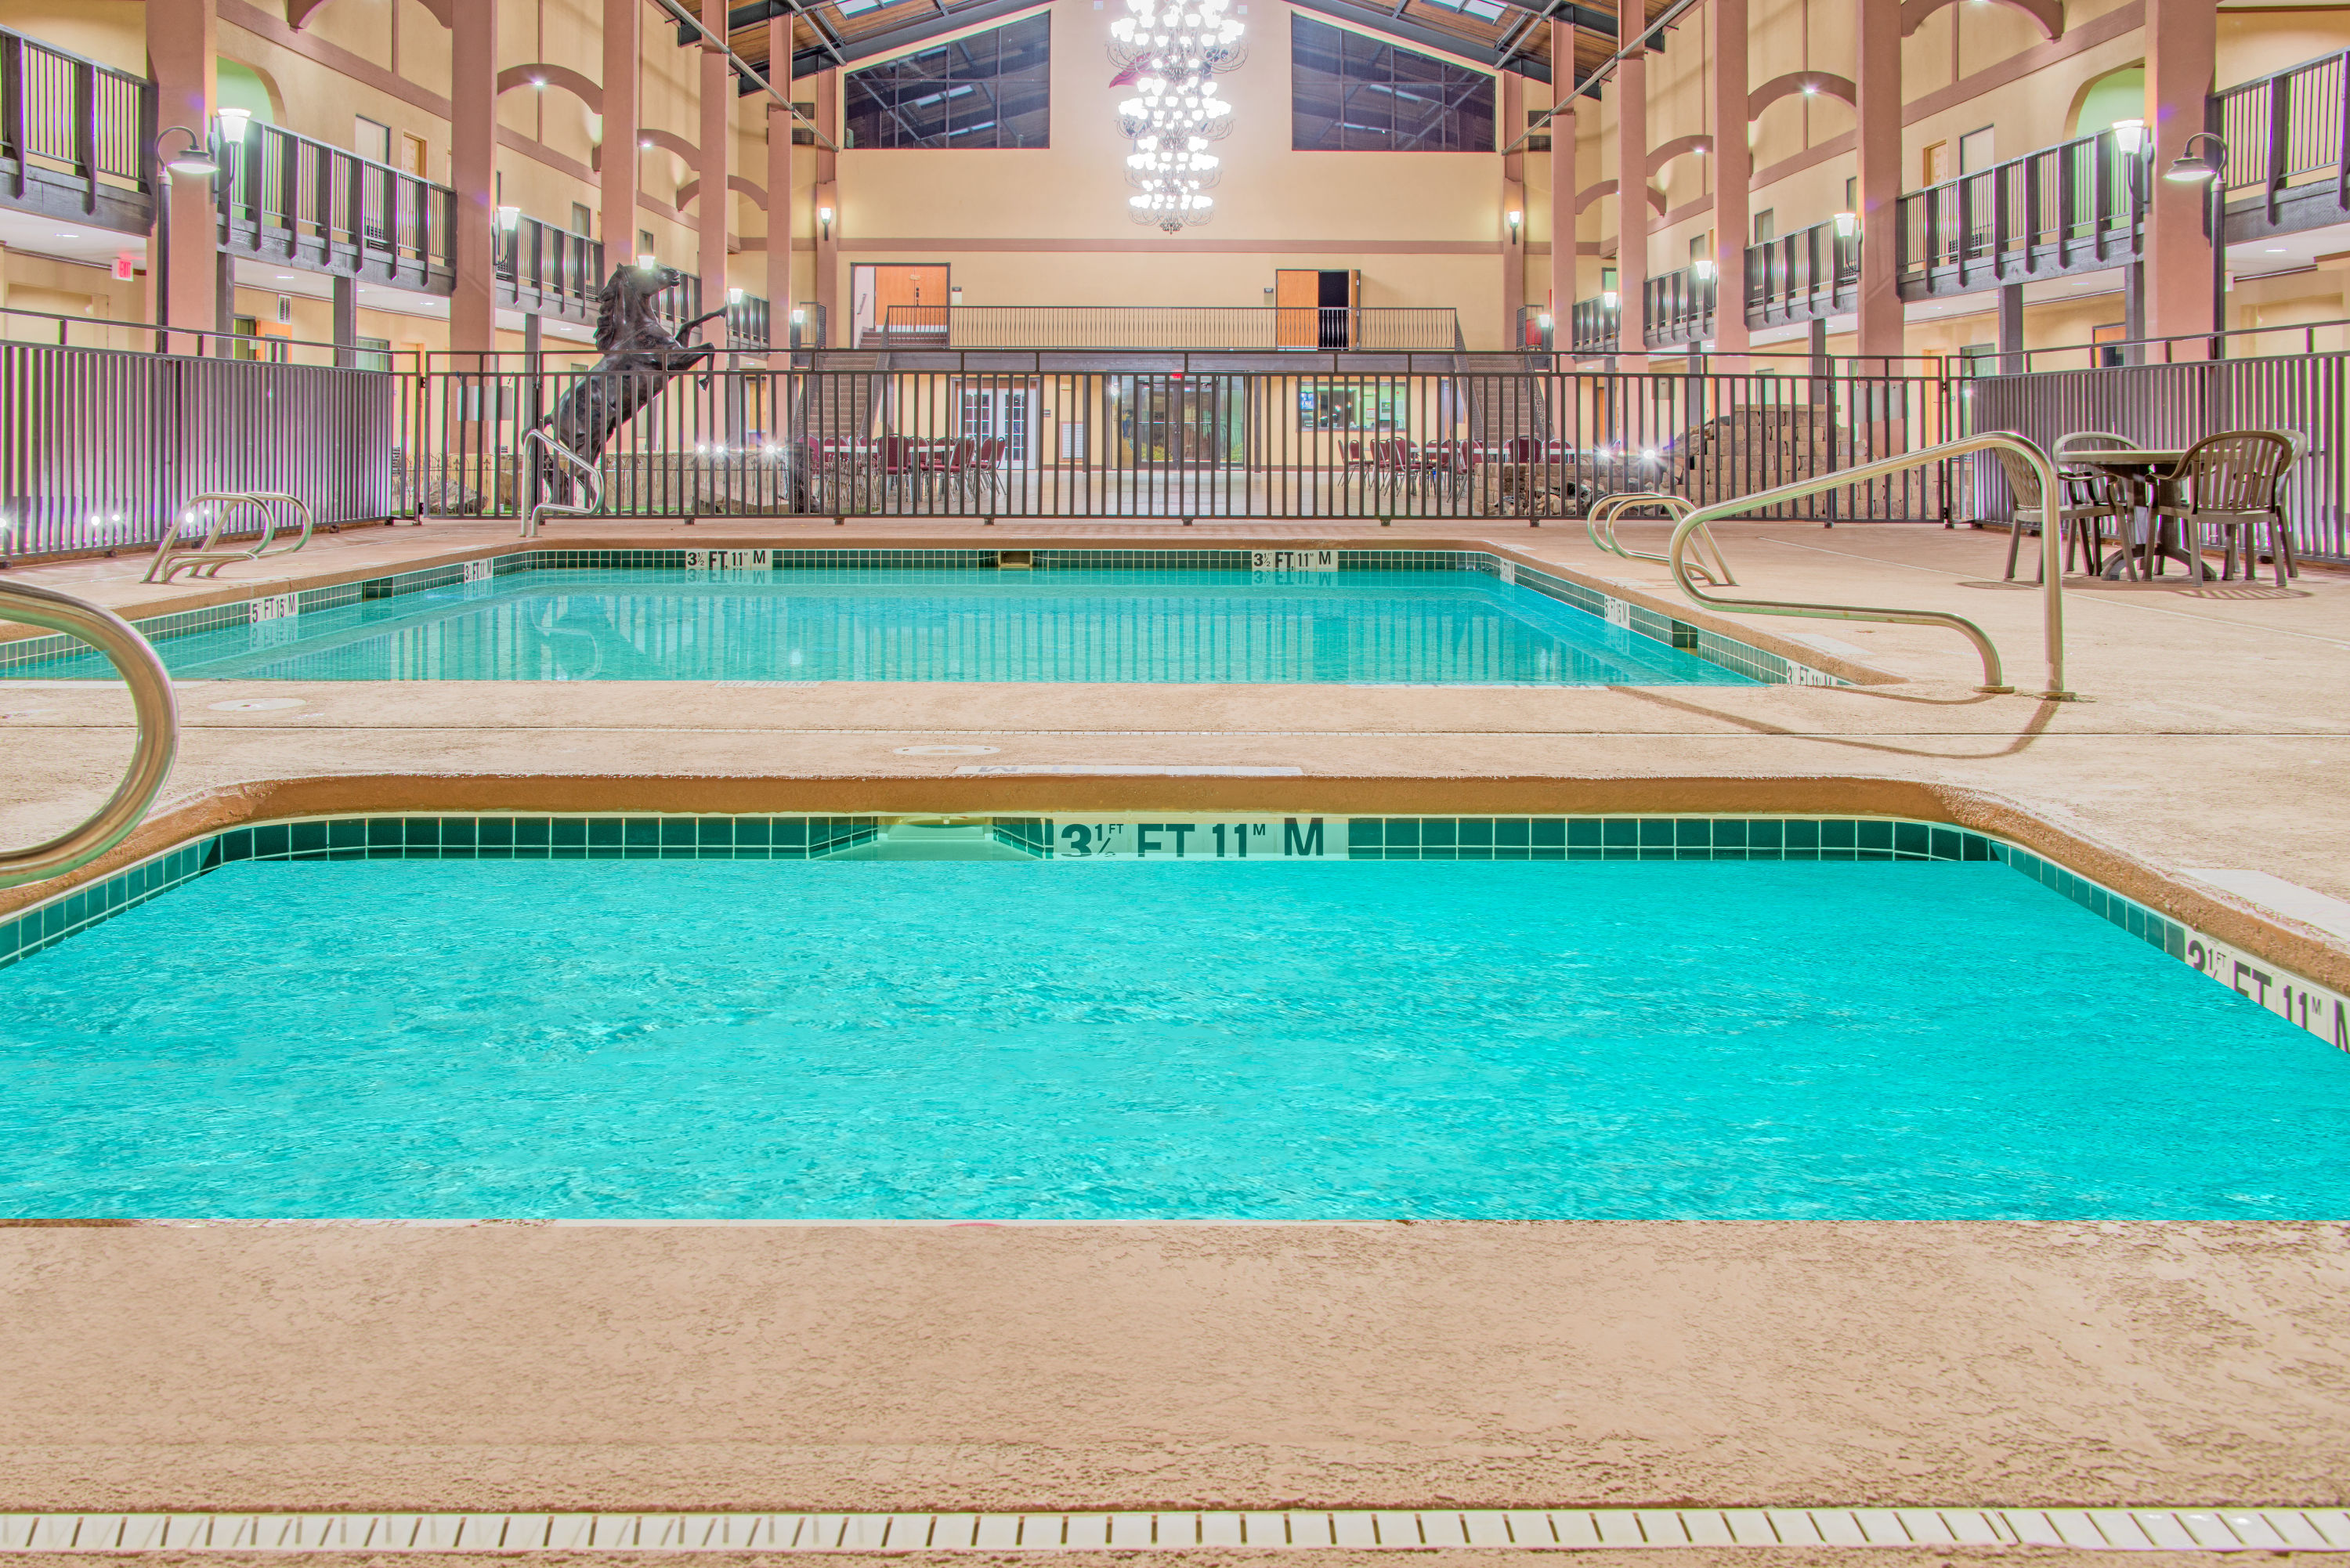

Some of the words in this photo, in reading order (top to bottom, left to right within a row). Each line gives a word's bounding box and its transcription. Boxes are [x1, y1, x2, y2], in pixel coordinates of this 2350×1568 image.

[119, 260, 132, 278] EXIT
[753, 550, 766, 564] M
[1318, 551, 1332, 565] M
[472, 562, 479, 580] FT
[264, 597, 275, 619] FT
[288, 594, 296, 614] M
[1799, 666, 1810, 686] FT
[1137, 822, 1196, 858] FT
[1284, 817, 1324, 857] M
[2233, 959, 2272, 1006] FT
